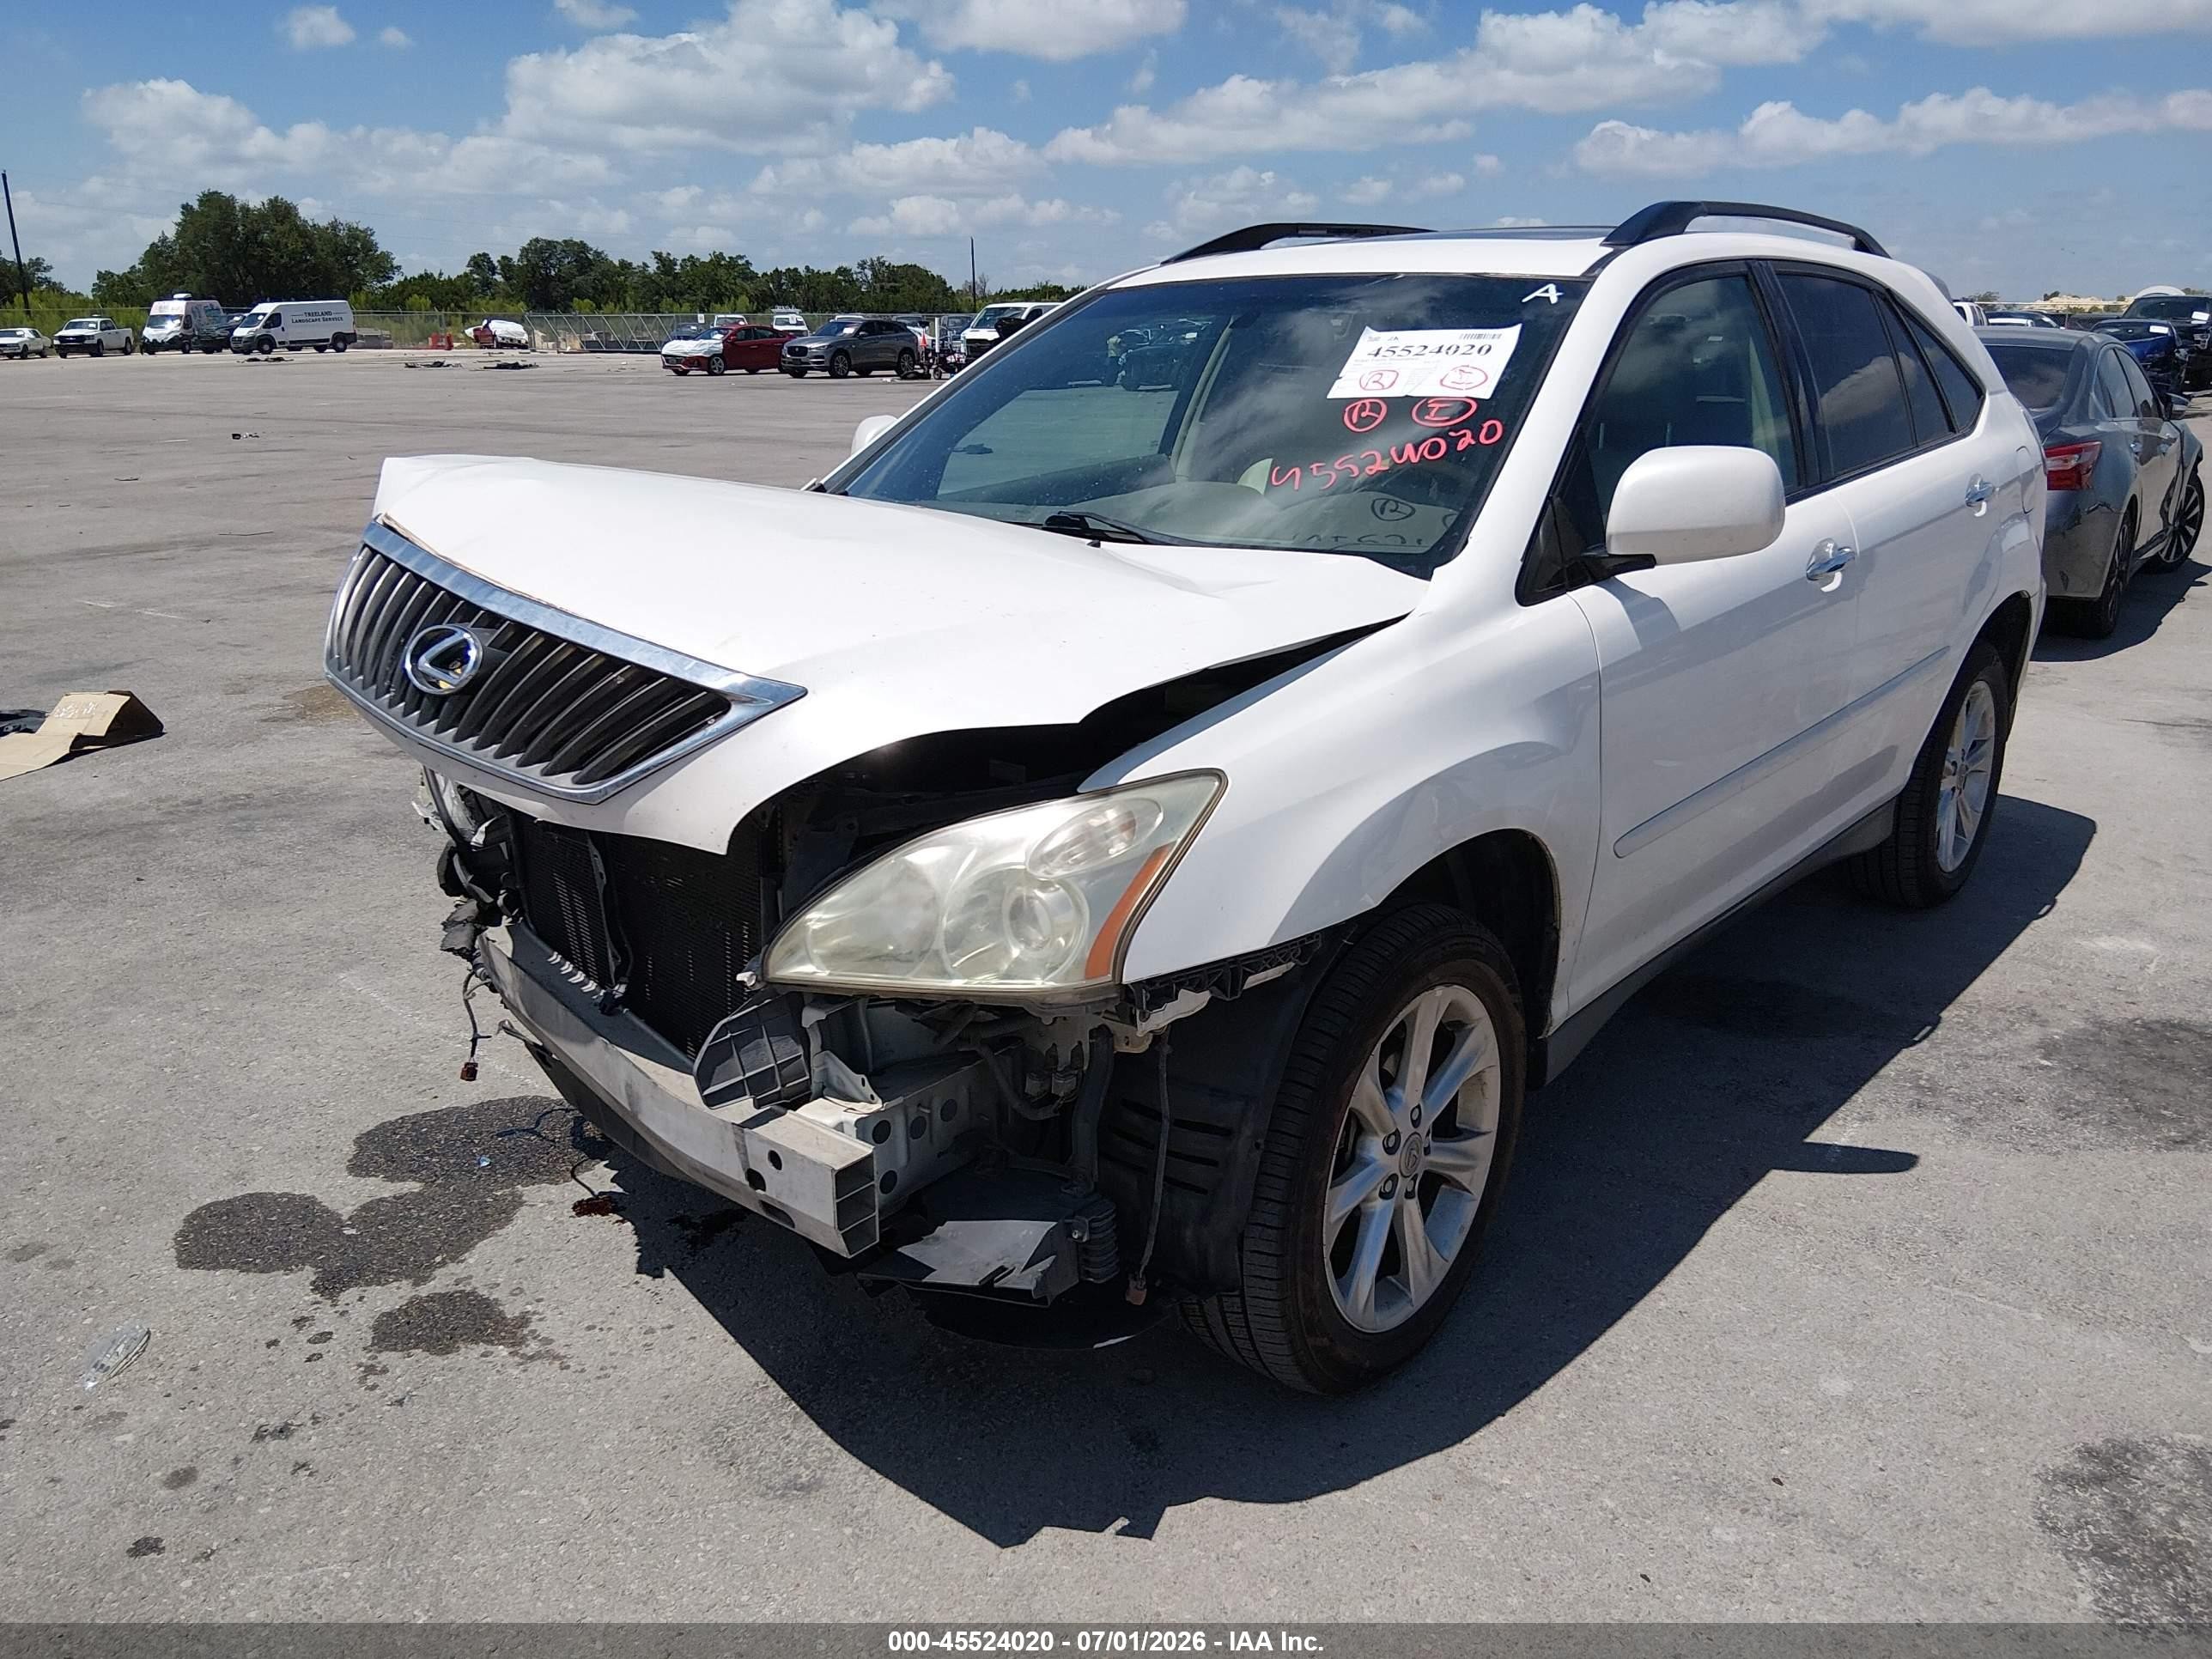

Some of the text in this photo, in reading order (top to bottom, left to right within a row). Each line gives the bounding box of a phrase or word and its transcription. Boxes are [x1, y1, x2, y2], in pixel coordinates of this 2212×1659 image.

[1522, 283, 1565, 304] A
[1367, 344, 1492, 357] 45524020
[1271, 420, 1504, 490] 45524020
